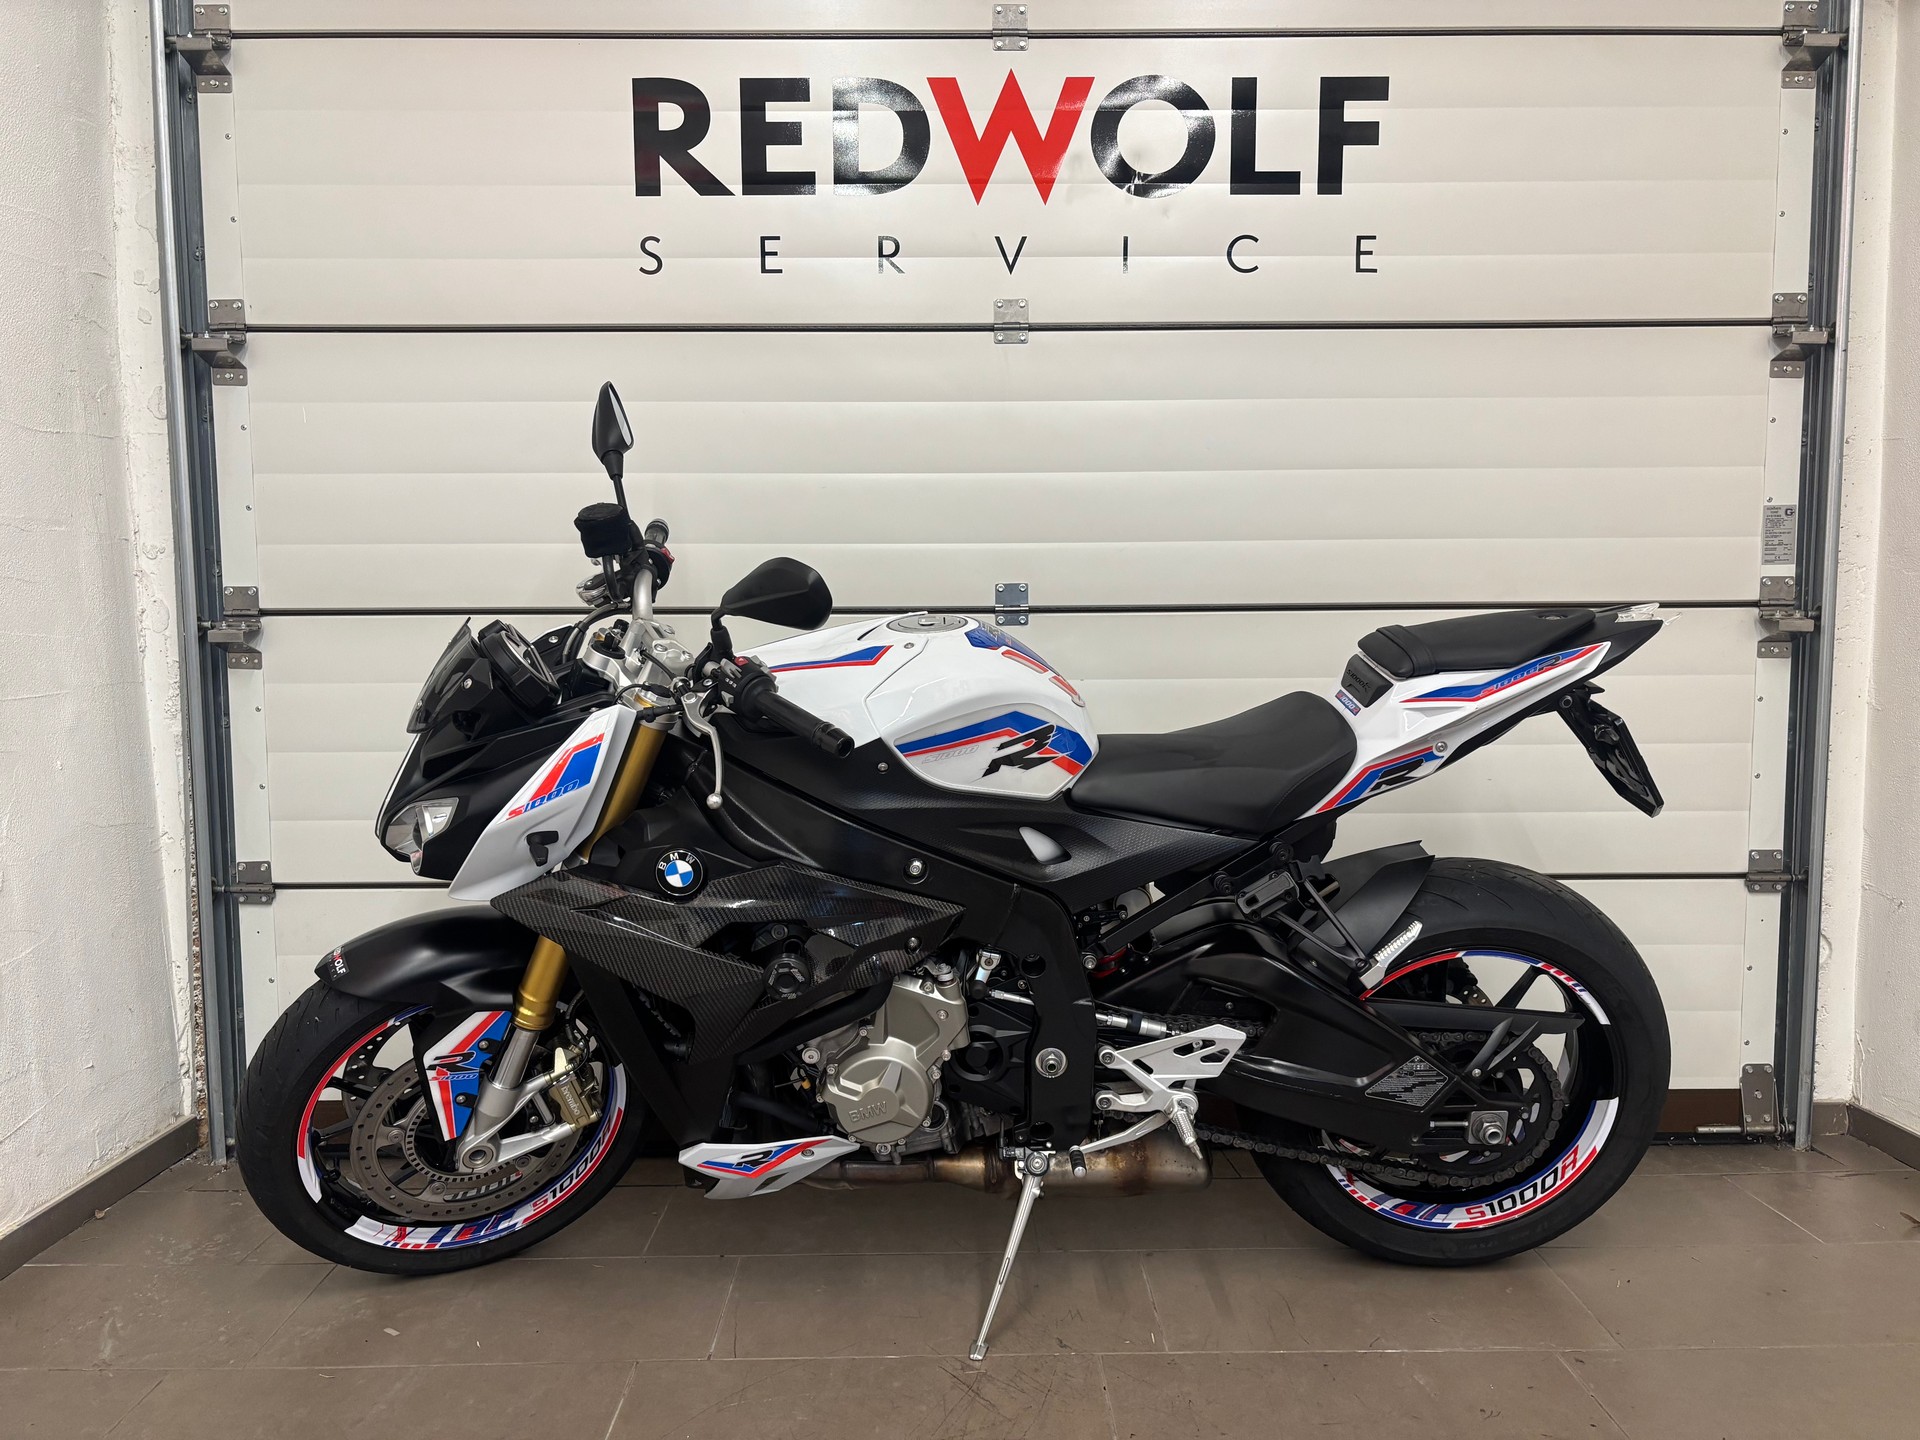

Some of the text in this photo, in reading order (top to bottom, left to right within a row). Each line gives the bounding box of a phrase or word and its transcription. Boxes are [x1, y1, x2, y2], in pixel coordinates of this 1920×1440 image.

[632, 67, 1389, 205] REDWOLF
[638, 234, 1378, 275] SERVICE
[658, 852, 696, 871] BMW
[560, 1084, 581, 1116] brembo
[848, 1100, 887, 1123] BMW
